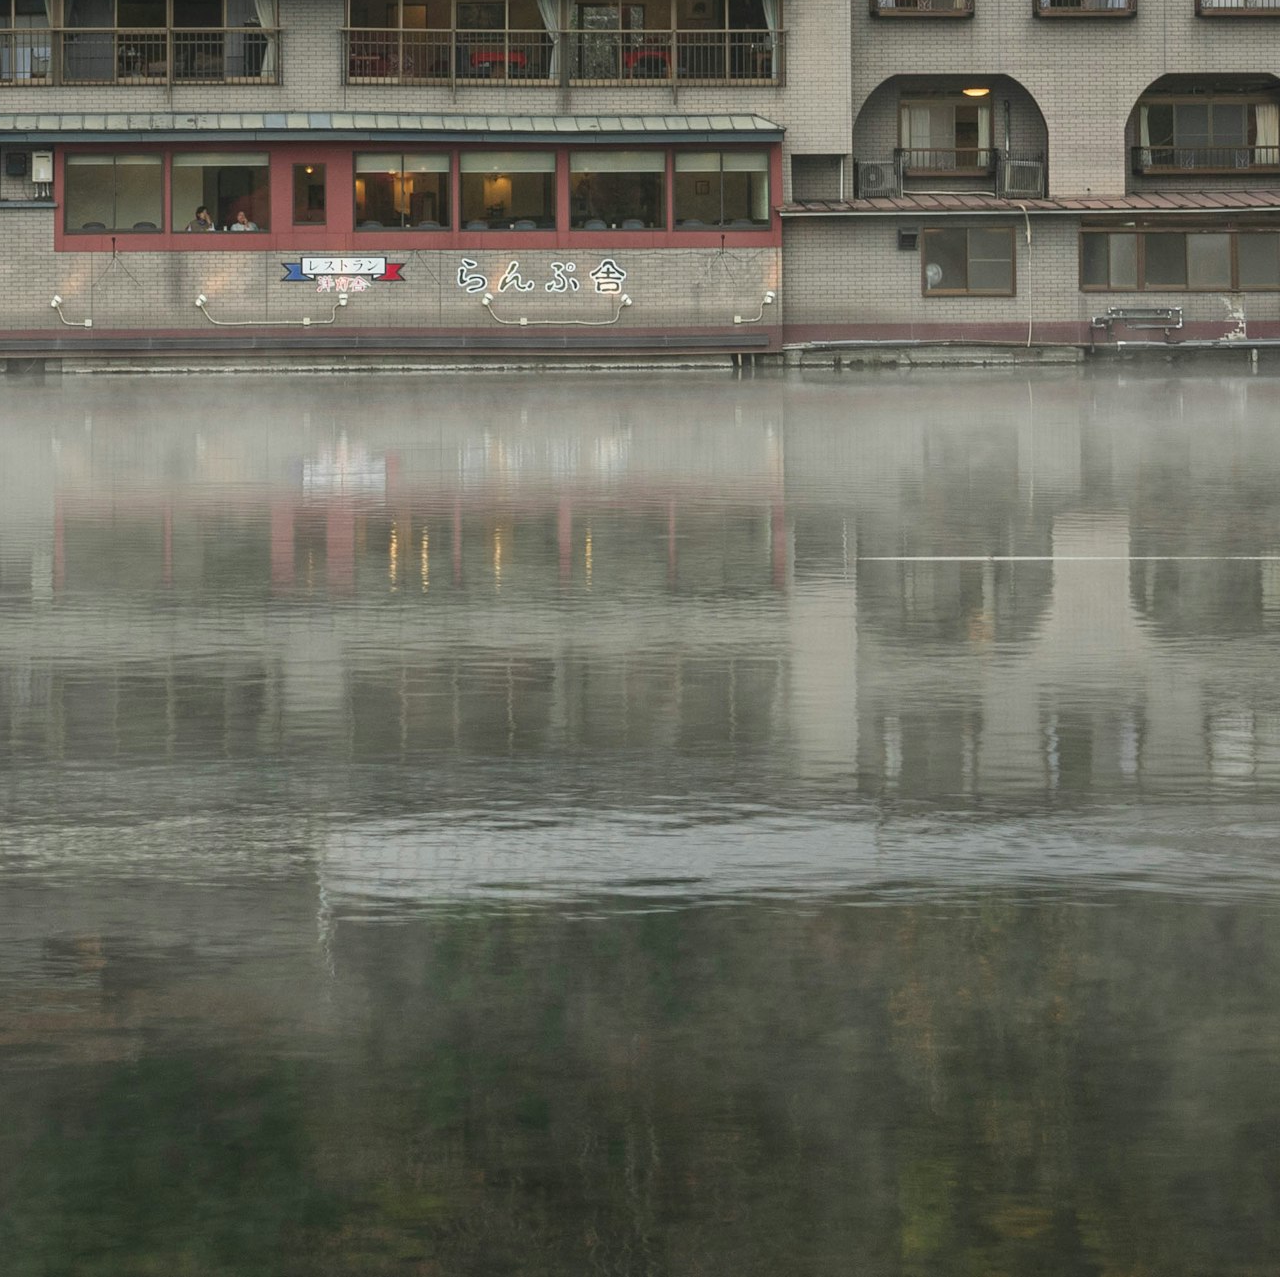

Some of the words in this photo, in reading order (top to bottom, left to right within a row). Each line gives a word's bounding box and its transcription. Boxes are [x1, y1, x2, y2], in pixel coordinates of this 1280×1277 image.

[308, 259, 379, 272] レストラン
[458, 258, 626, 294] らんぷ舎
